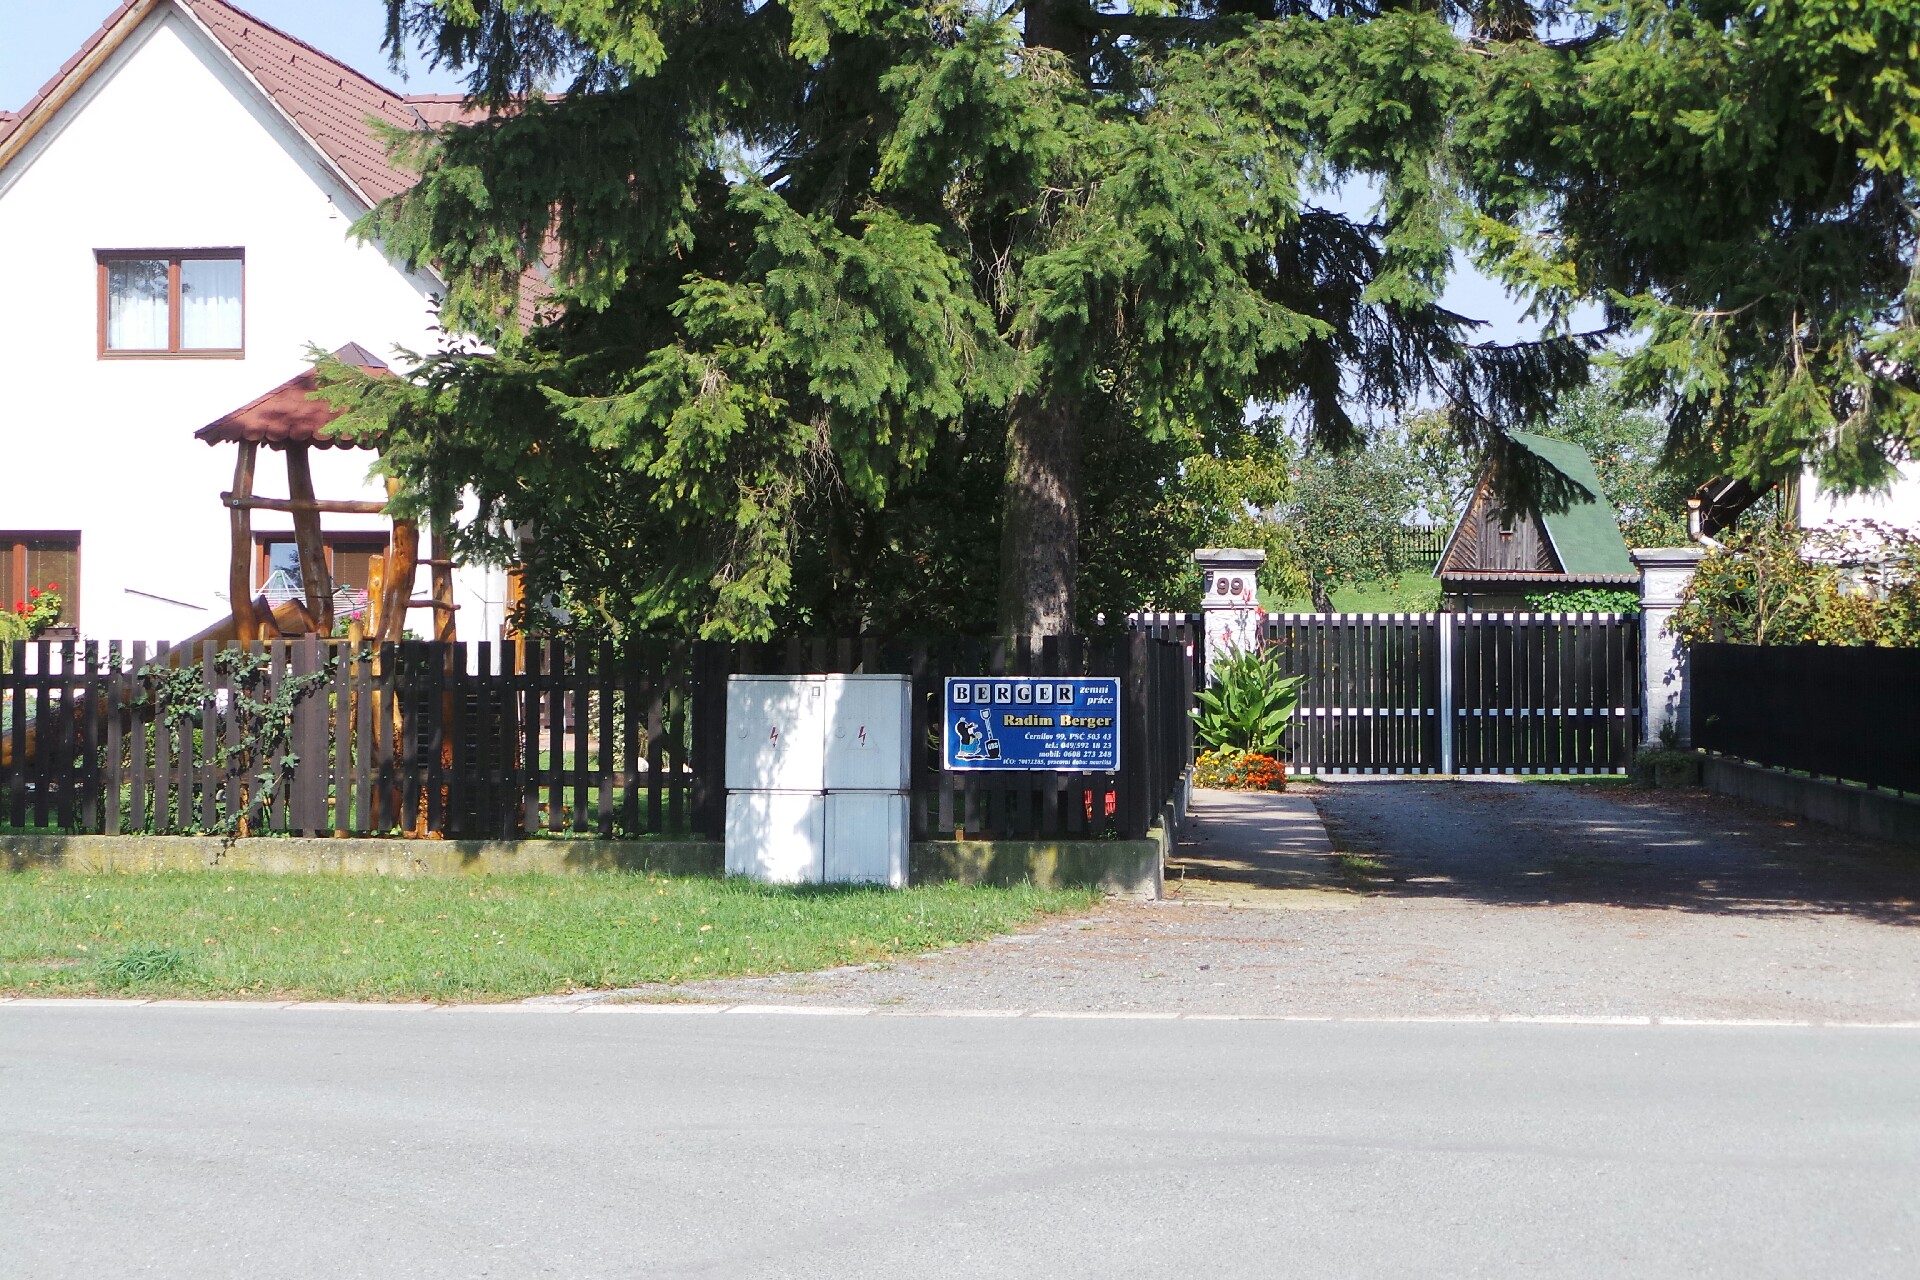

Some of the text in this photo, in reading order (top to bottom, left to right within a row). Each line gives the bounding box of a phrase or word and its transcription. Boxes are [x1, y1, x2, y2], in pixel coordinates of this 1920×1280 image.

[1217, 577, 1244, 596] 99
[956, 686, 1072, 701] BERGER
[1086, 694, 1114, 706] práce
[1003, 714, 1113, 729] Radim Berger
[1038, 750, 1061, 758] mobil:
[1083, 750, 1096, 758] 273
[1098, 750, 1112, 758] 248
